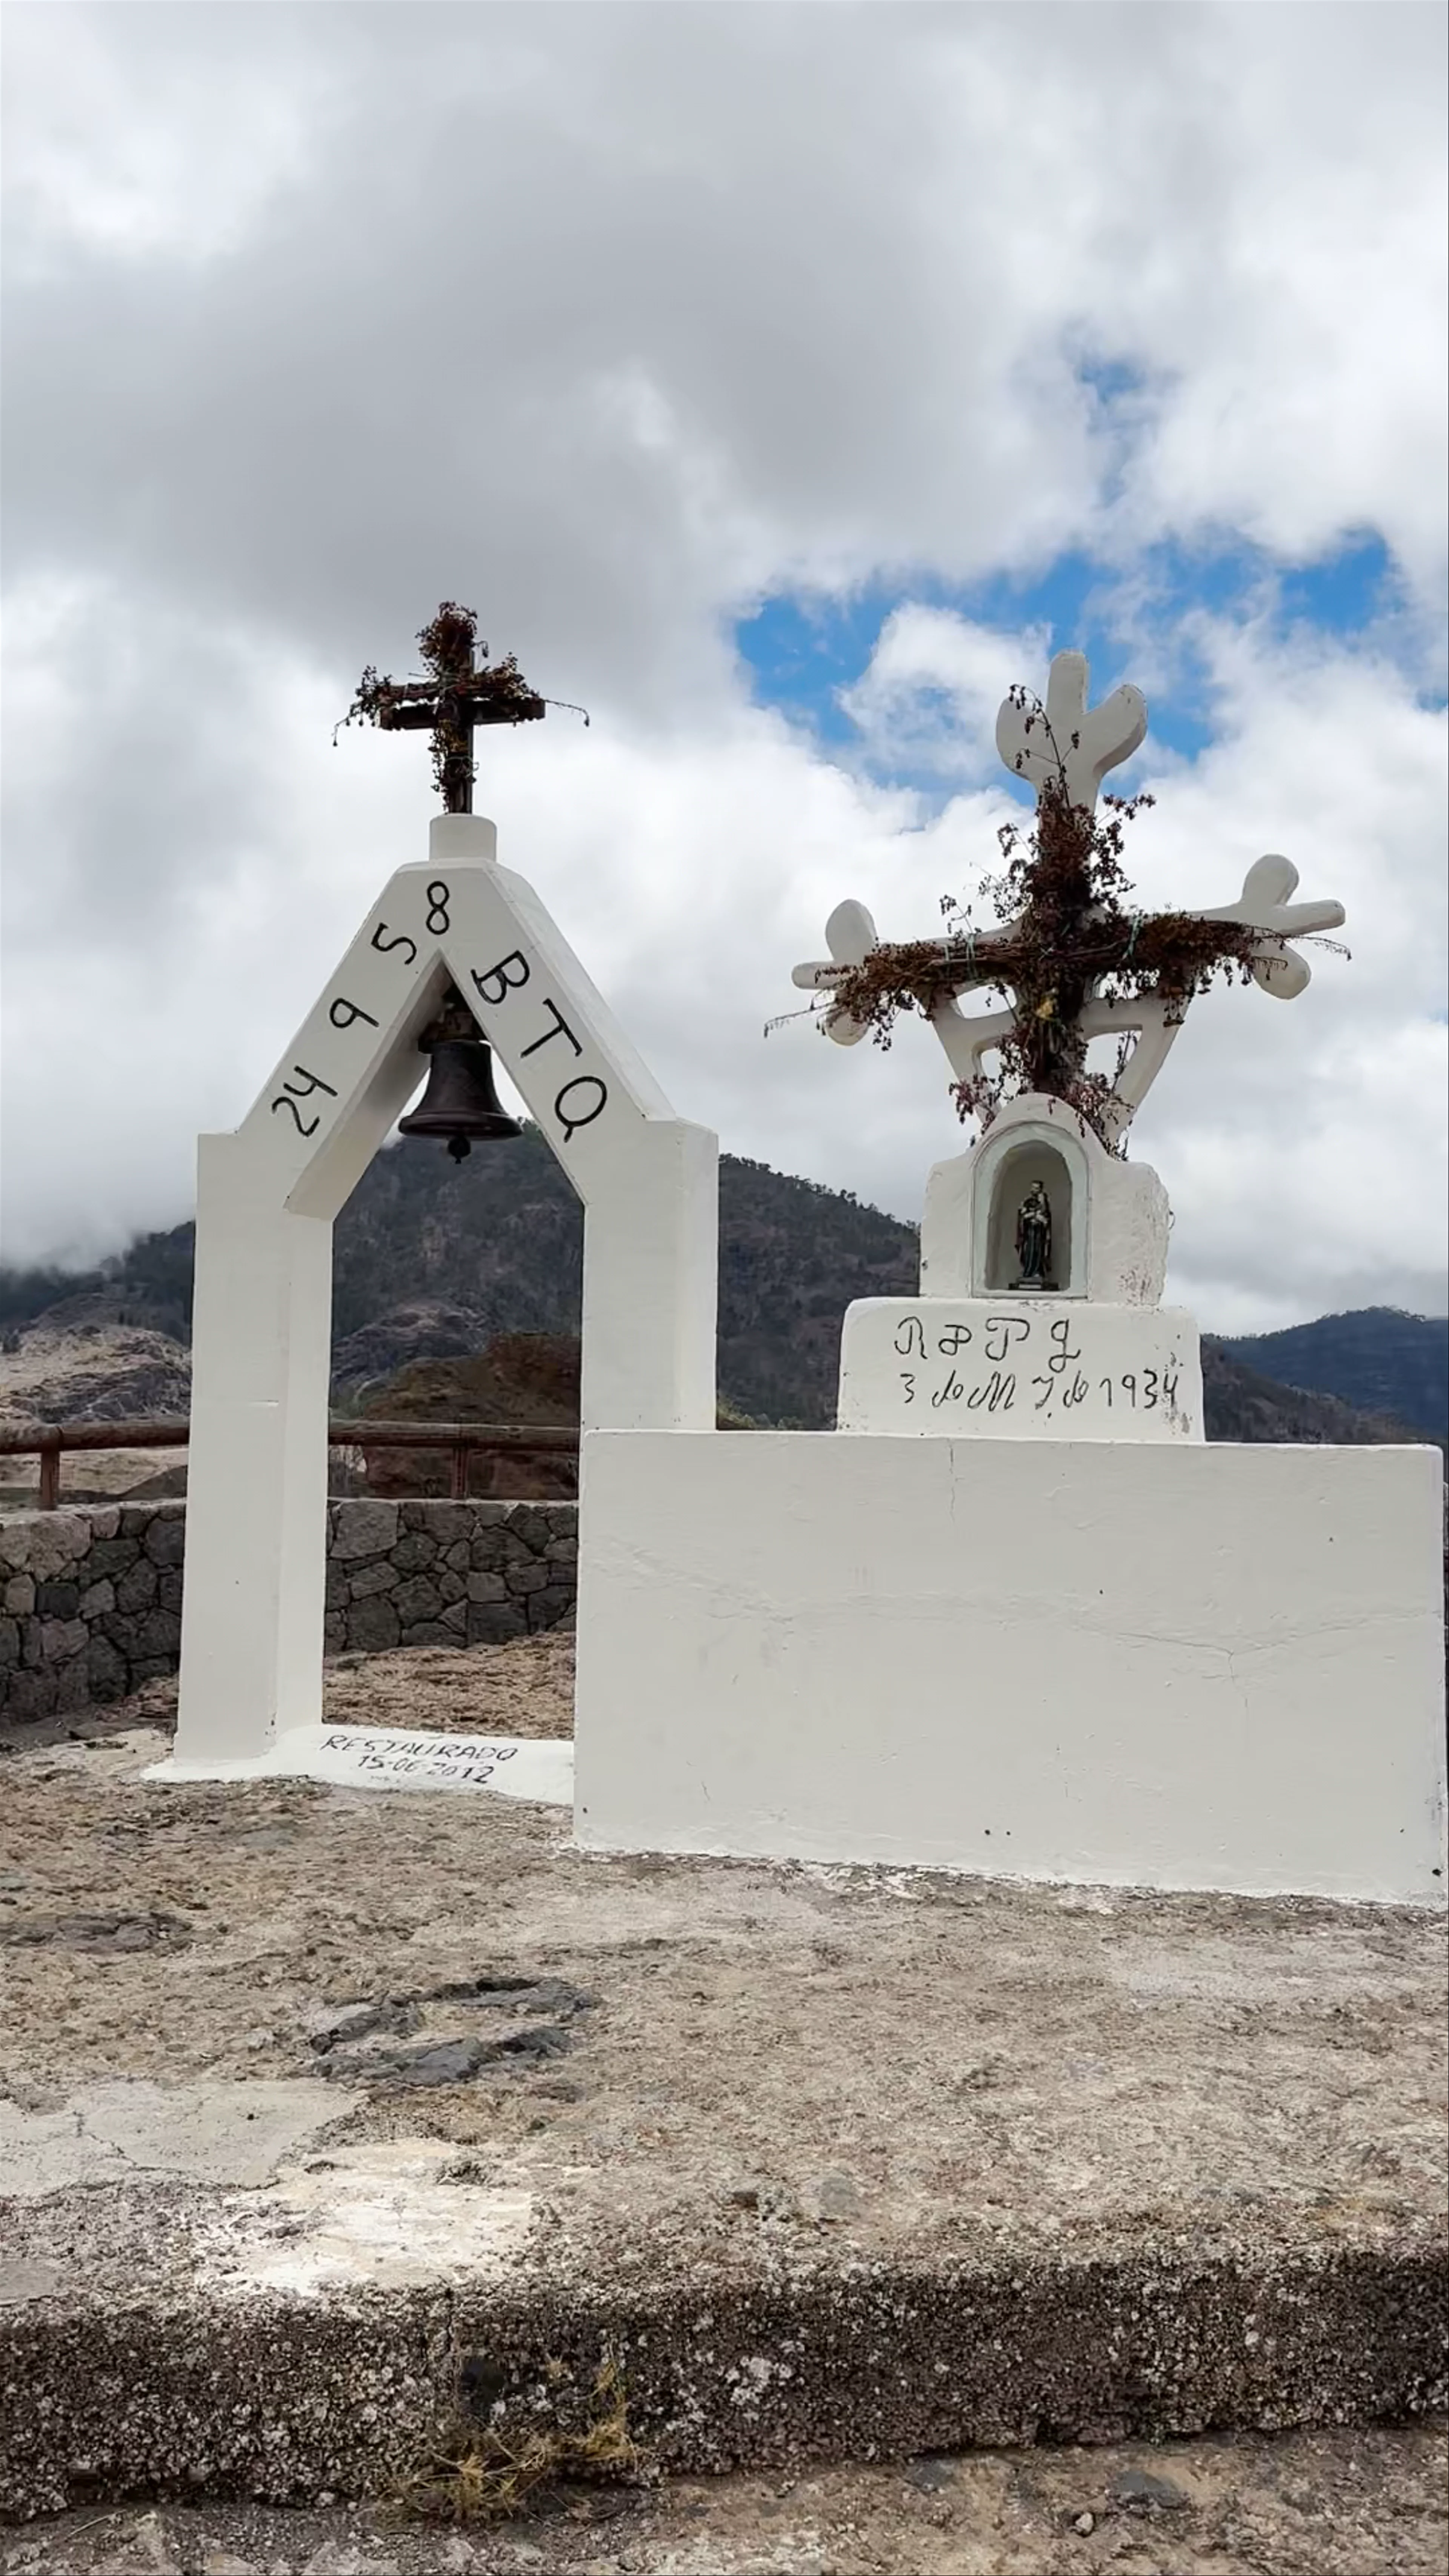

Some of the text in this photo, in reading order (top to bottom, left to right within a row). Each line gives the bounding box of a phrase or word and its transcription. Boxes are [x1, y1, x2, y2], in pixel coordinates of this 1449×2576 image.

[271, 1065, 338, 1138] 24
[329, 997, 380, 1029] 9
[899, 1372, 916, 1404] 3
[1099, 1367, 1179, 1409] 1934
[320, 1735, 518, 1762] RESTAURADO
